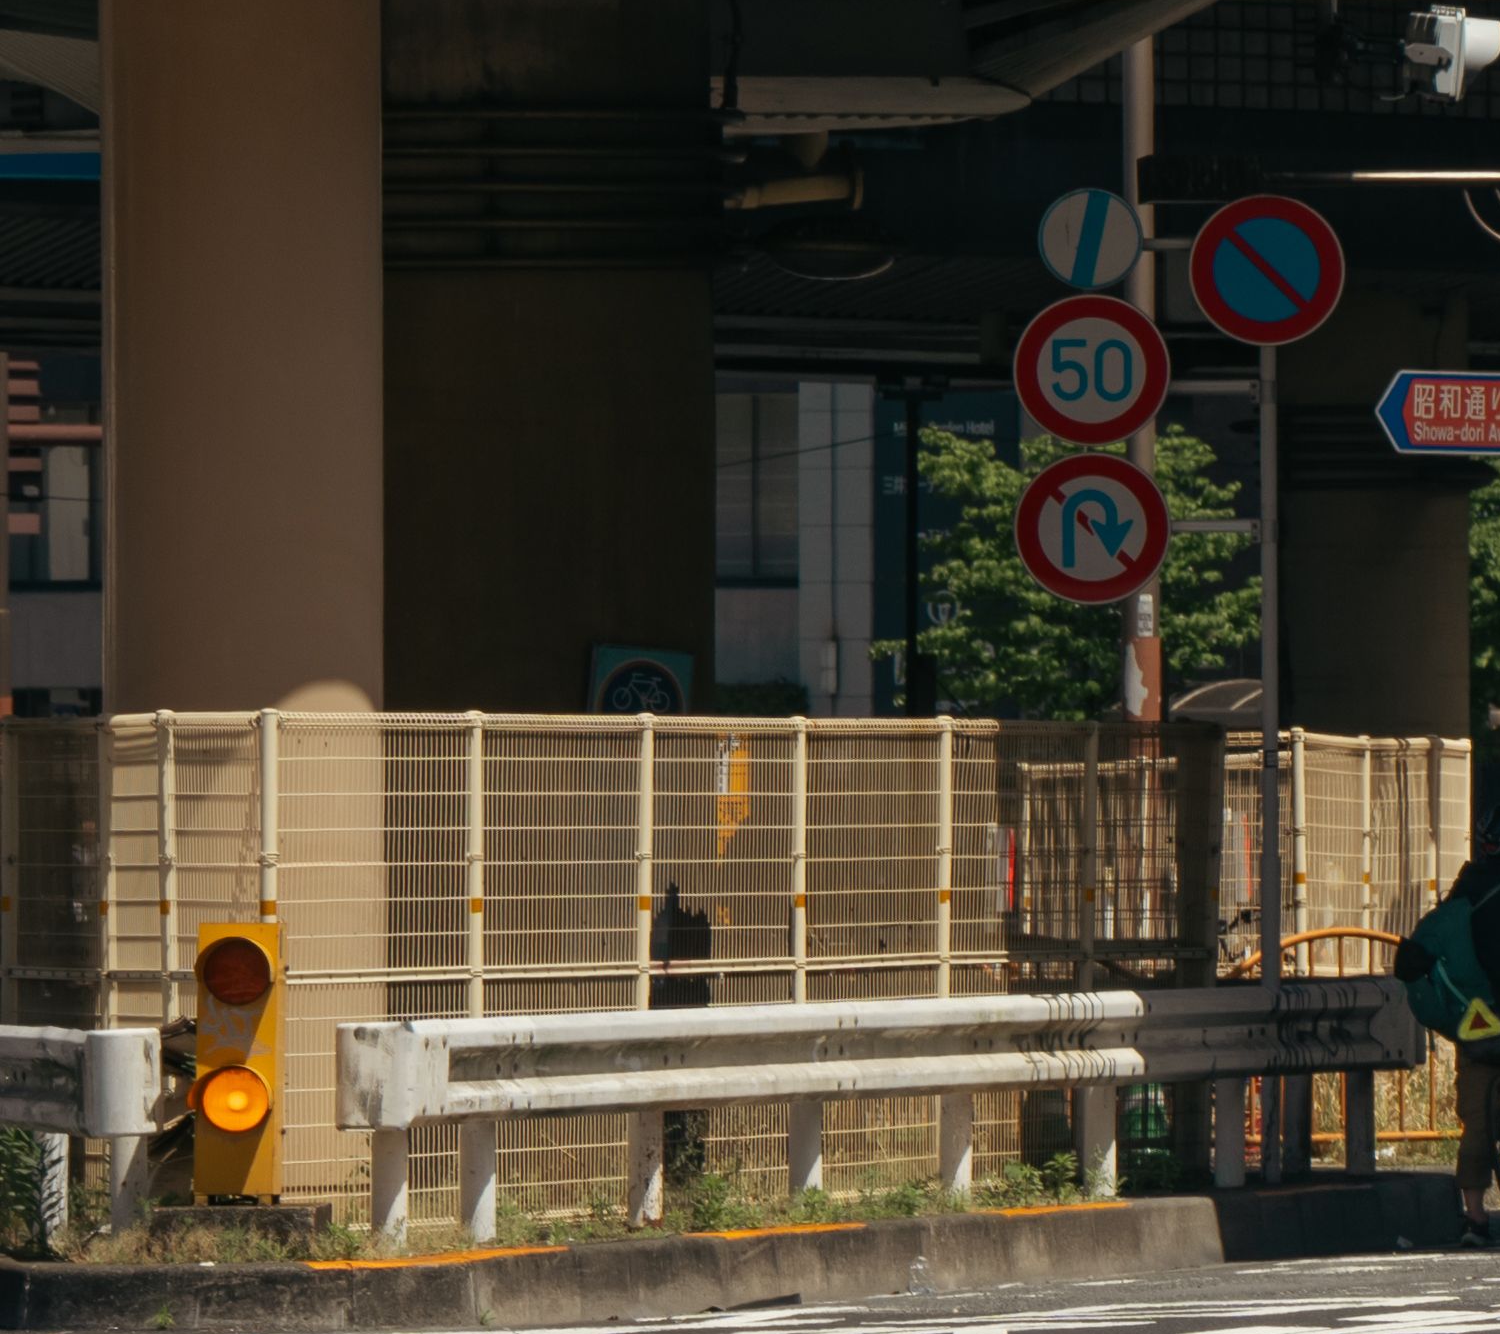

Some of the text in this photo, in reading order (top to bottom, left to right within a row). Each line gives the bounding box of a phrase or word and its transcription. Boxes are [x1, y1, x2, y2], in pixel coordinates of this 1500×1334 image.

[1051, 339, 1133, 402] 50
[966, 419, 994, 435] Hotel
[1413, 422, 1485, 443] Showa-dori
